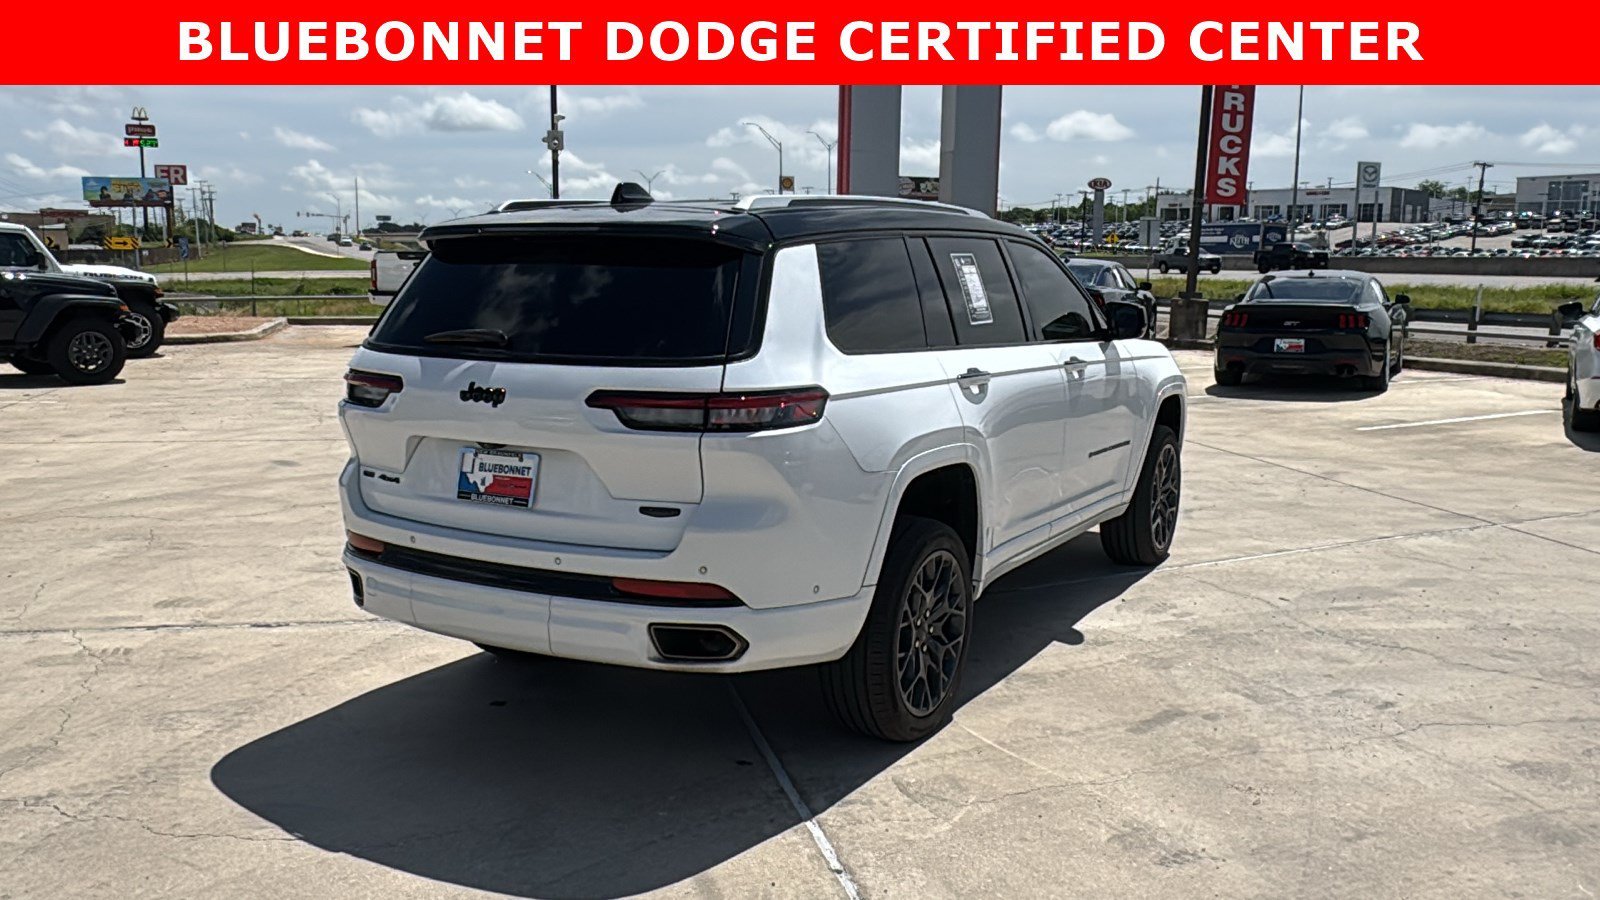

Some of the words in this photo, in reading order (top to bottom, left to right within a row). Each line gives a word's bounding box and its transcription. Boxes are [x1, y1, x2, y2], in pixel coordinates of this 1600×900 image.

[1217, 85, 1245, 197] RUCKS
[156, 166, 184, 183] ER
[1091, 179, 1110, 188] KIA
[460, 381, 506, 408] Jeep
[478, 462, 531, 476] BLUEBONNET
[471, 494, 513, 504] BLUEBONNET
